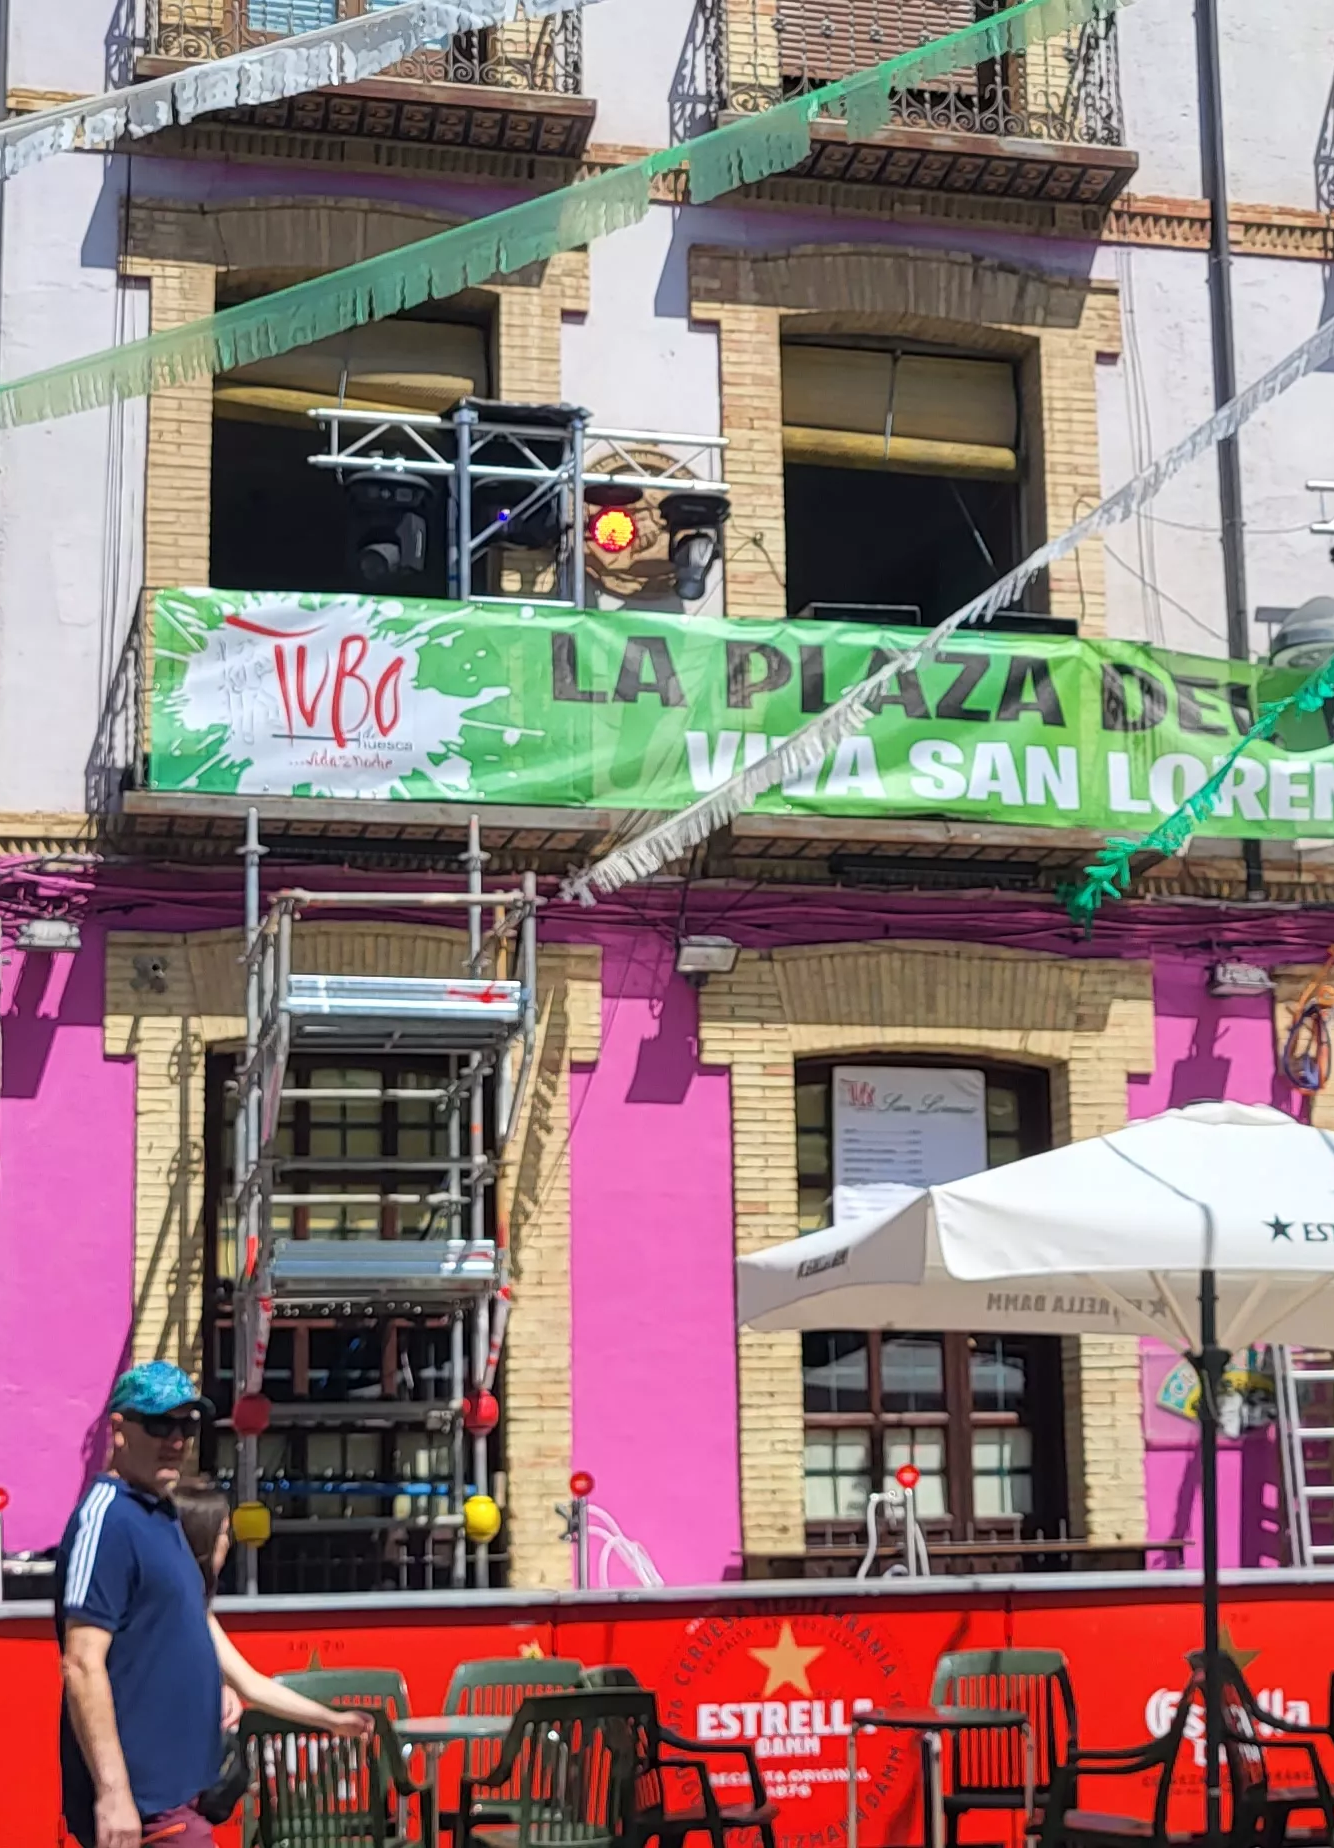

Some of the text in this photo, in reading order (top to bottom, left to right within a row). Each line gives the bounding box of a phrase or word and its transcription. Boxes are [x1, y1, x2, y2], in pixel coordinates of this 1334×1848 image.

[551, 631, 688, 708] LA
[725, 640, 1066, 728] PLAZA
[908, 739, 1081, 811] SAN
[755, 1735, 821, 1759] DAMM
